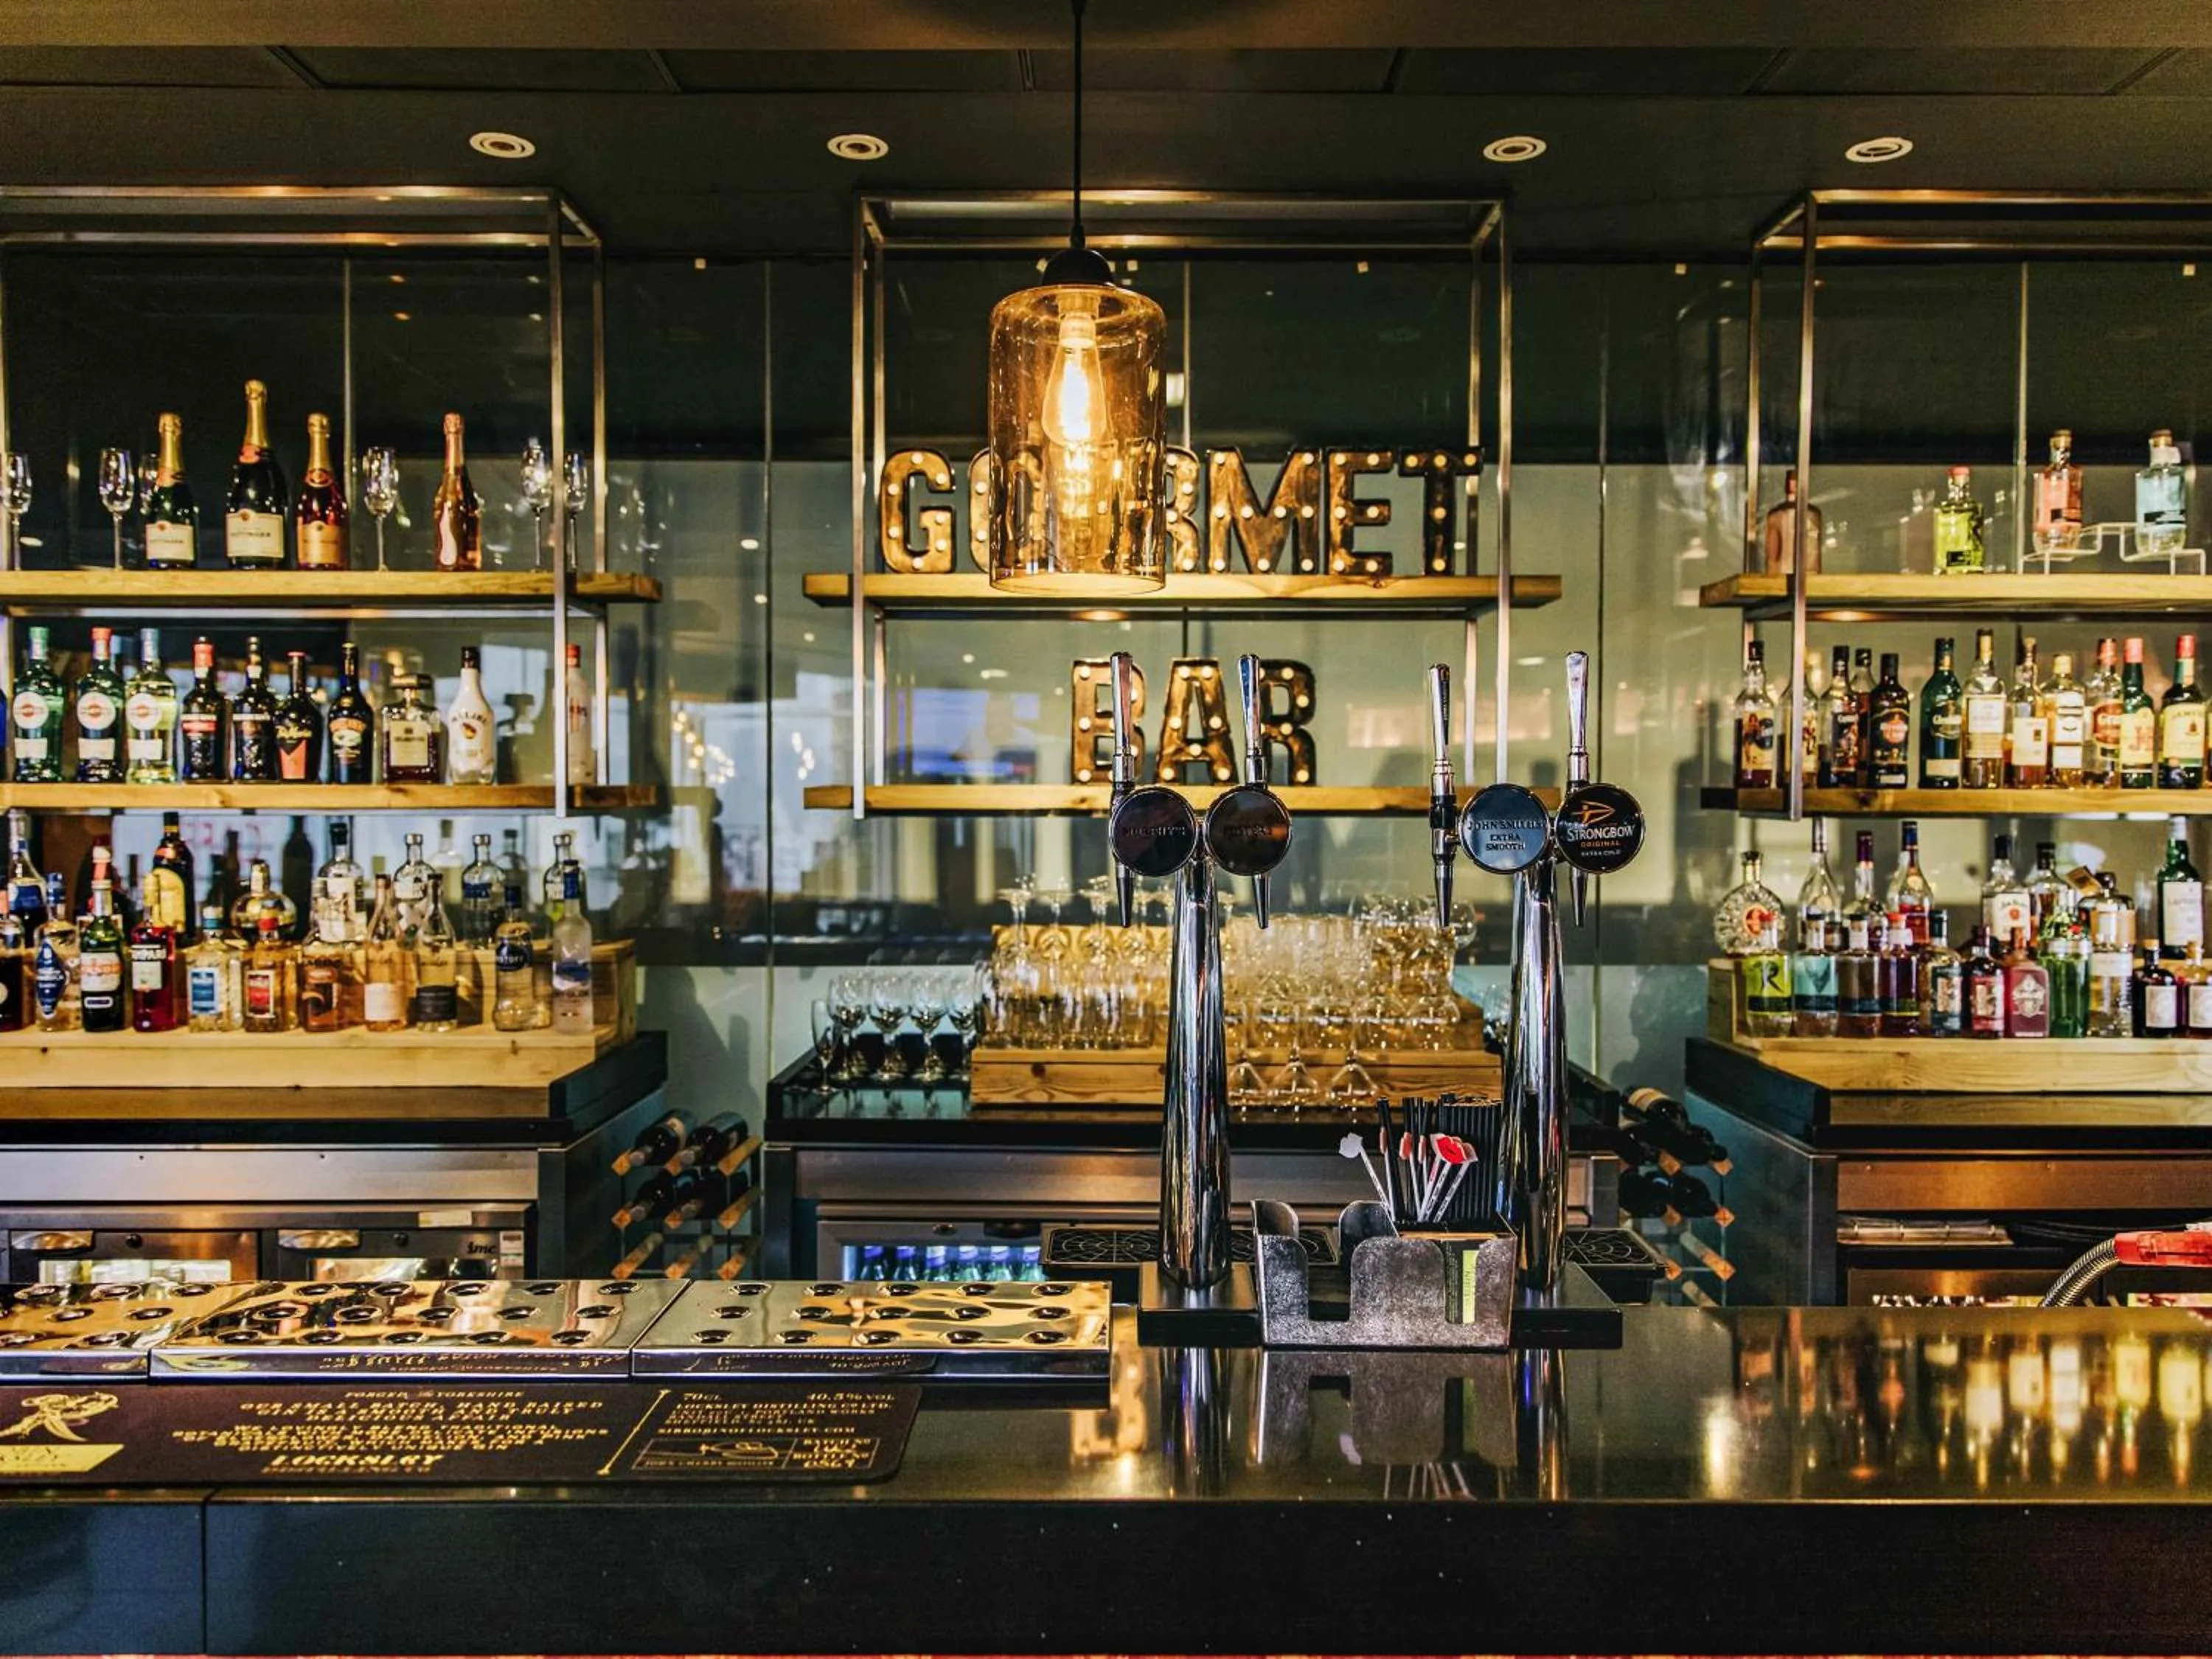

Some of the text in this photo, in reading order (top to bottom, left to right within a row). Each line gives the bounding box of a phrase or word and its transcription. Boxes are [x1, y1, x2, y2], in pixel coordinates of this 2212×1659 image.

[1070, 656, 1317, 787] BAR
[1467, 819, 1498, 830] JOHN
[1489, 833, 1521, 841] EXTRA
[1567, 823, 1635, 842] STRONGBOW
[1486, 842, 1526, 851] SMOOTH
[1580, 840, 1621, 848] ORIGINAL
[271, 1454, 445, 1467] LOCKSLEY
